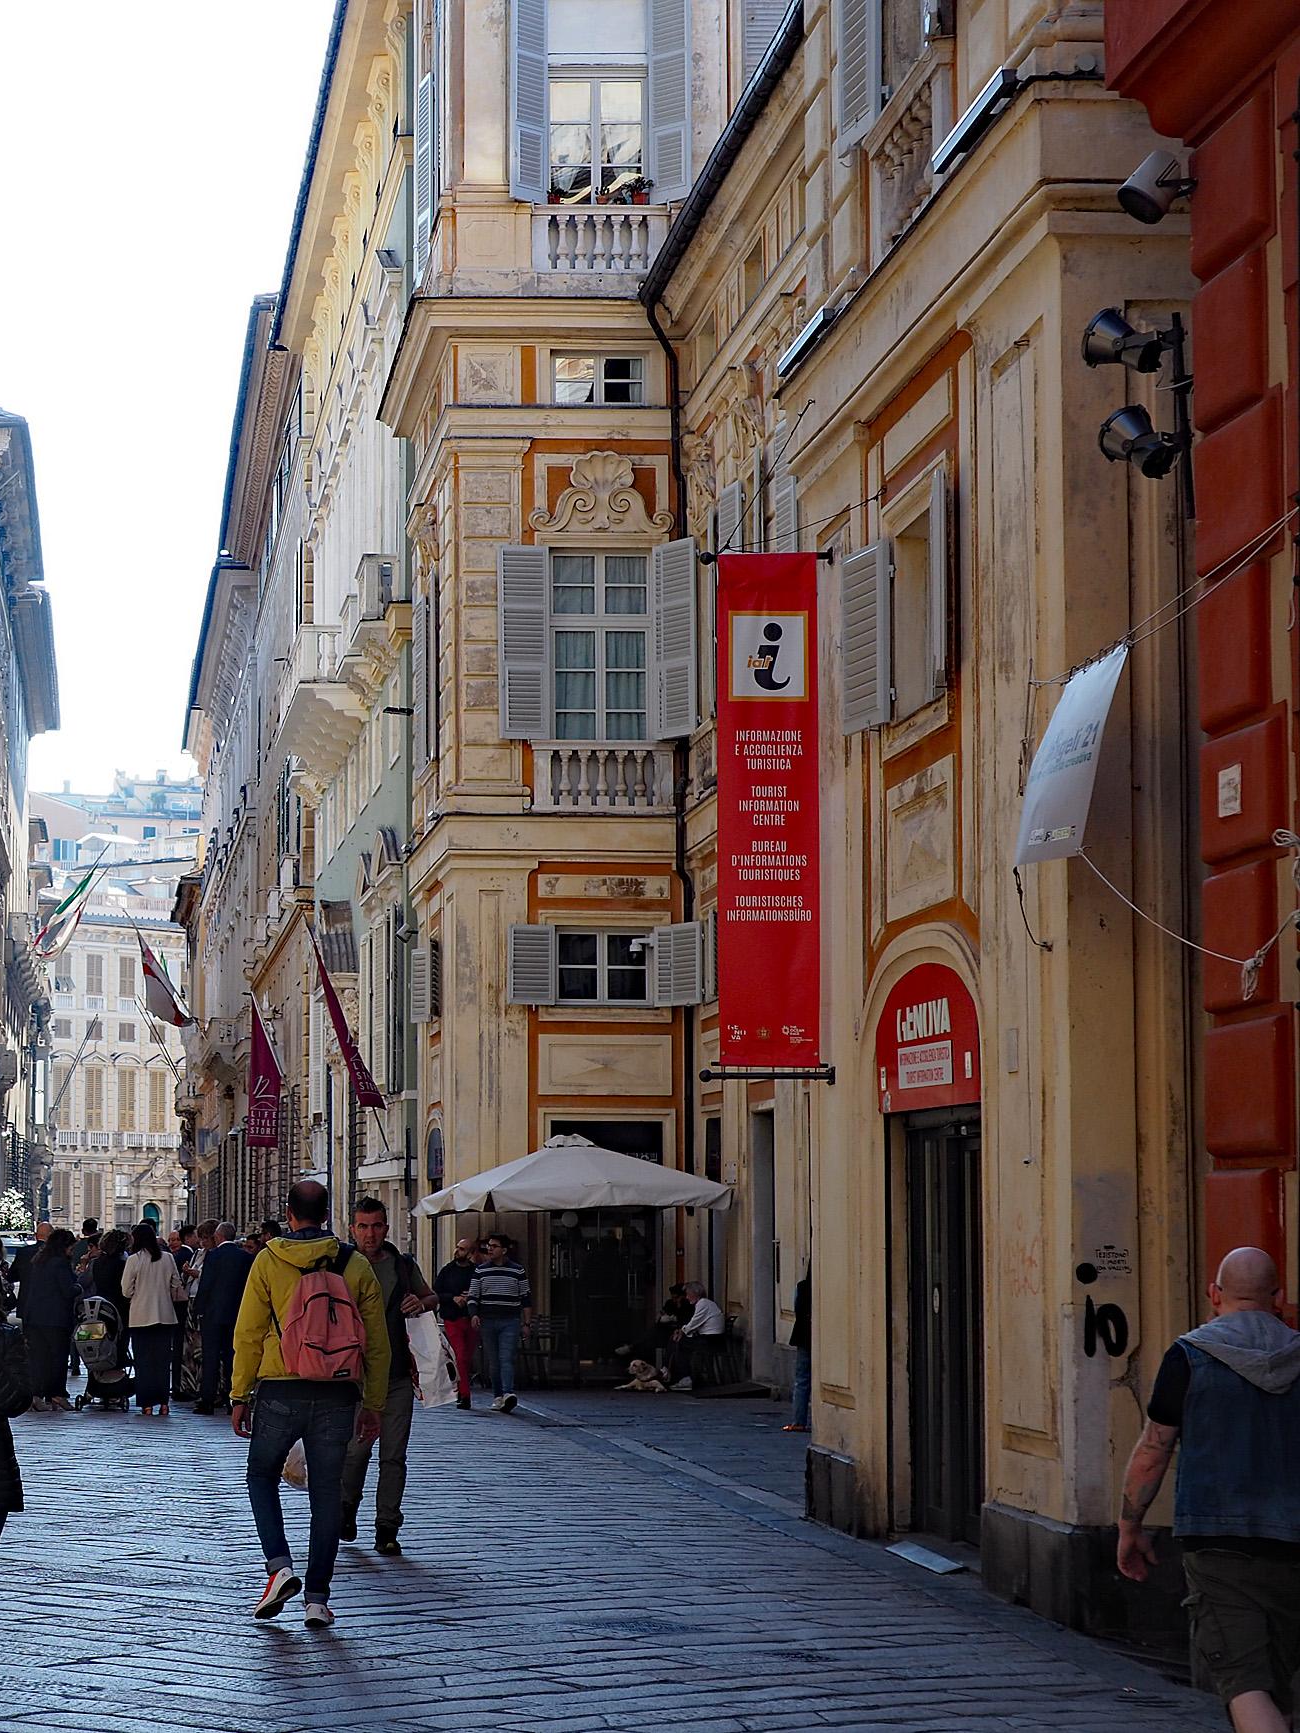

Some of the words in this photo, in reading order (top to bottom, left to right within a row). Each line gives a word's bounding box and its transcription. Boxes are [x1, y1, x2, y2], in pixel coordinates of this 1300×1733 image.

[736, 730, 802, 742] INFORMAZIONE
[735, 744, 740, 756] E
[743, 744, 803, 756] ACCOGLIENZA
[746, 758, 792, 770] TURISTICA
[751, 785, 787, 797] TOURIST
[739, 800, 799, 812] INFORMATION
[753, 814, 785, 826] CENTRE
[752, 840, 787, 852] BUREAU
[732, 854, 807, 867] D'INFORMATIONS
[738, 869, 800, 881] TOURISTIQUES
[735, 896, 803, 908] TOURISTISCHES
[727, 908, 812, 922] INFORMATIONSBÜRO
[252, 1075, 277, 1099] 12
[250, 1111, 277, 1119] LIFE
[250, 1119, 277, 1127] STYLE
[250, 1127, 276, 1135] STORE
